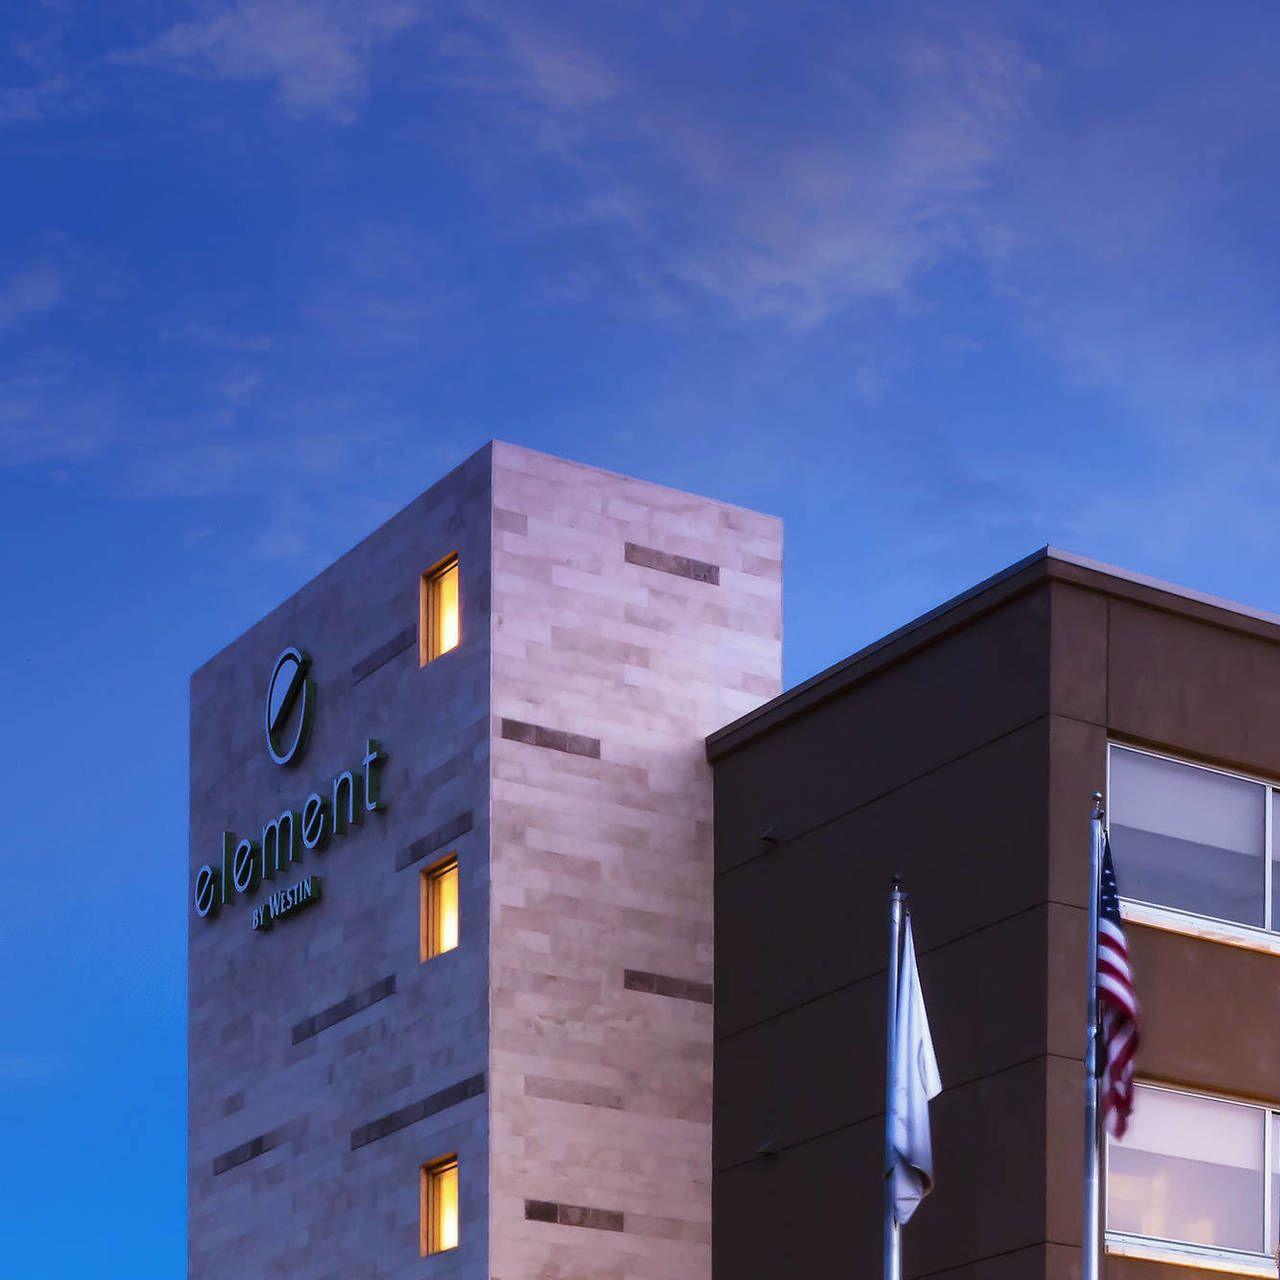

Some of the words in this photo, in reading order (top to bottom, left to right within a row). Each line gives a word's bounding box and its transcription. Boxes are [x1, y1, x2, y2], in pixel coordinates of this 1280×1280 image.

[193, 736, 379, 918] element
[251, 904, 267, 930] BY
[269, 877, 313, 919] WESTIN
